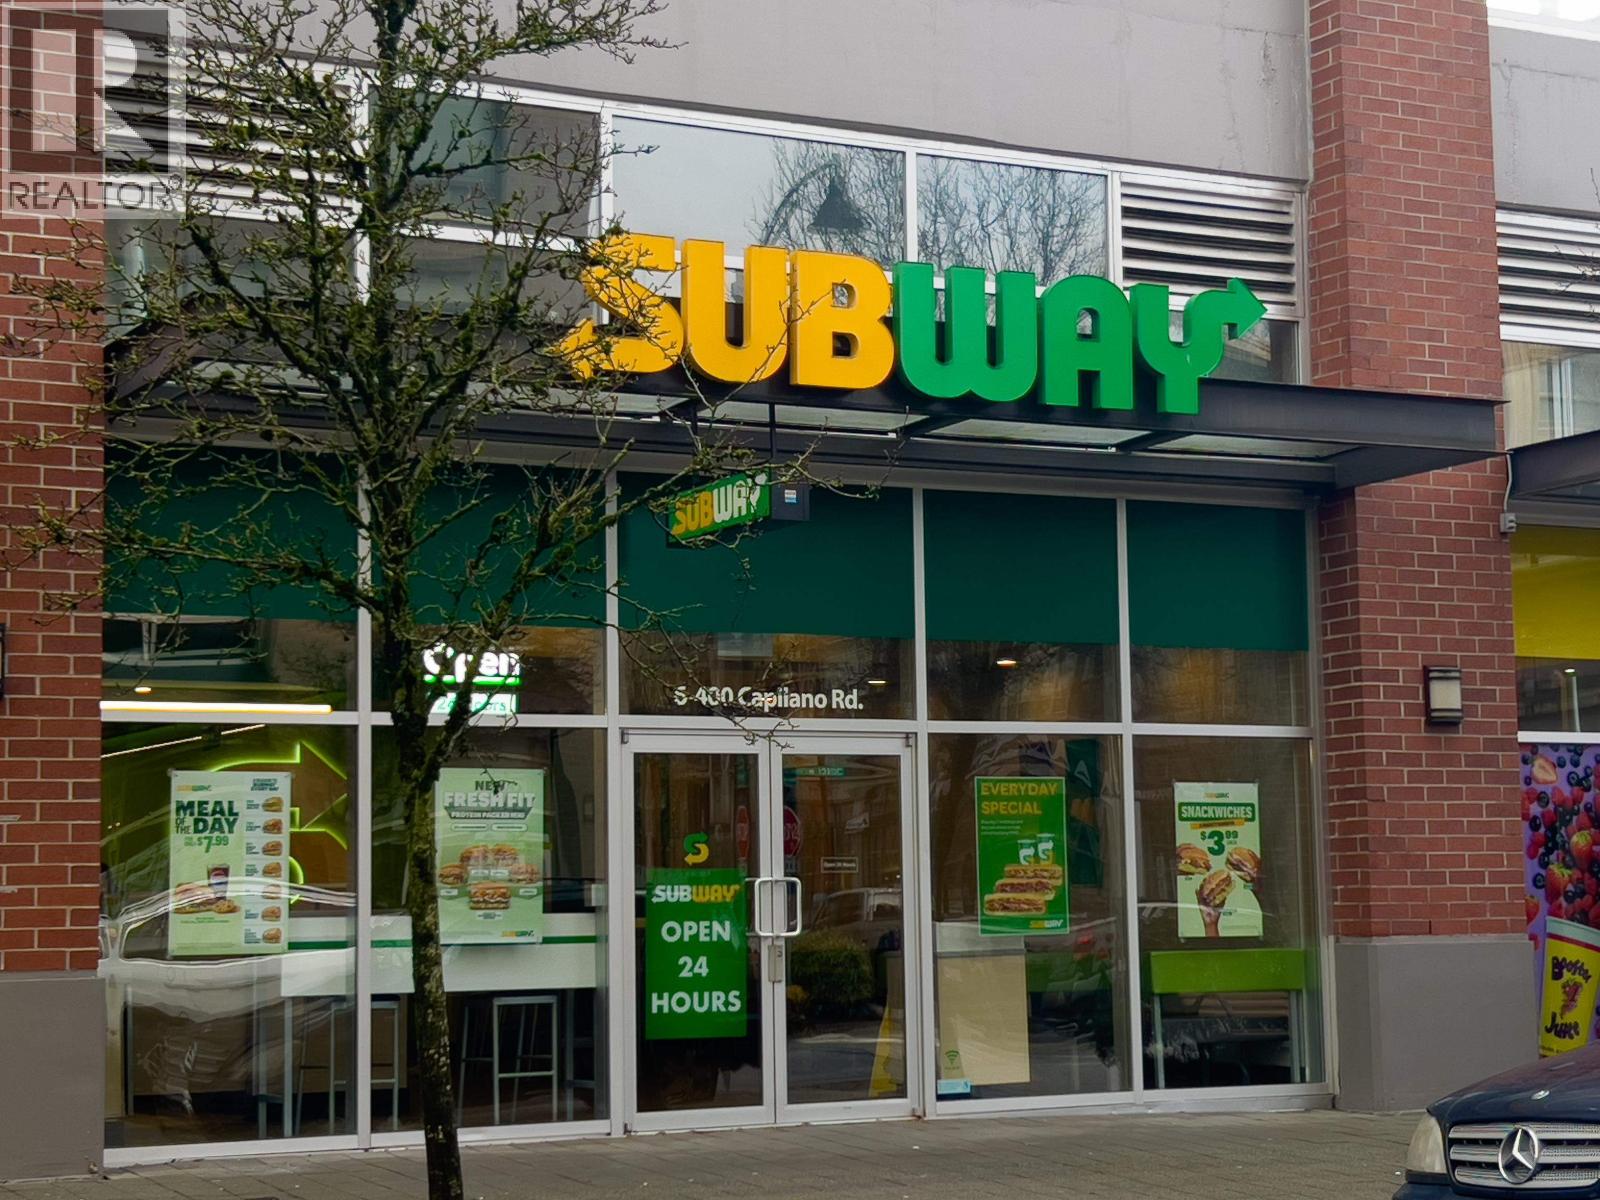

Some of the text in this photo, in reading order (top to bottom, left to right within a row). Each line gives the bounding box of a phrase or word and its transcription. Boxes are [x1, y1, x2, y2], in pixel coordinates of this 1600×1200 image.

[549, 232, 1267, 414] SUBWAY
[671, 473, 767, 535] SUBWAY
[737, 685, 827, 711] Capilano
[831, 688, 864, 710] Rd.
[443, 791, 536, 808] FRESH FIT
[980, 783, 1058, 796] EVERYDAY
[175, 800, 239, 817] MEAL
[981, 801, 1043, 815] SPECIAL
[1181, 805, 1253, 818] SNACKWICHES
[193, 817, 238, 834] DAY
[651, 884, 741, 904] SUBWAY
[661, 920, 731, 943] OPEN
[678, 956, 710, 978] 24
[651, 990, 742, 1014] HOURS
